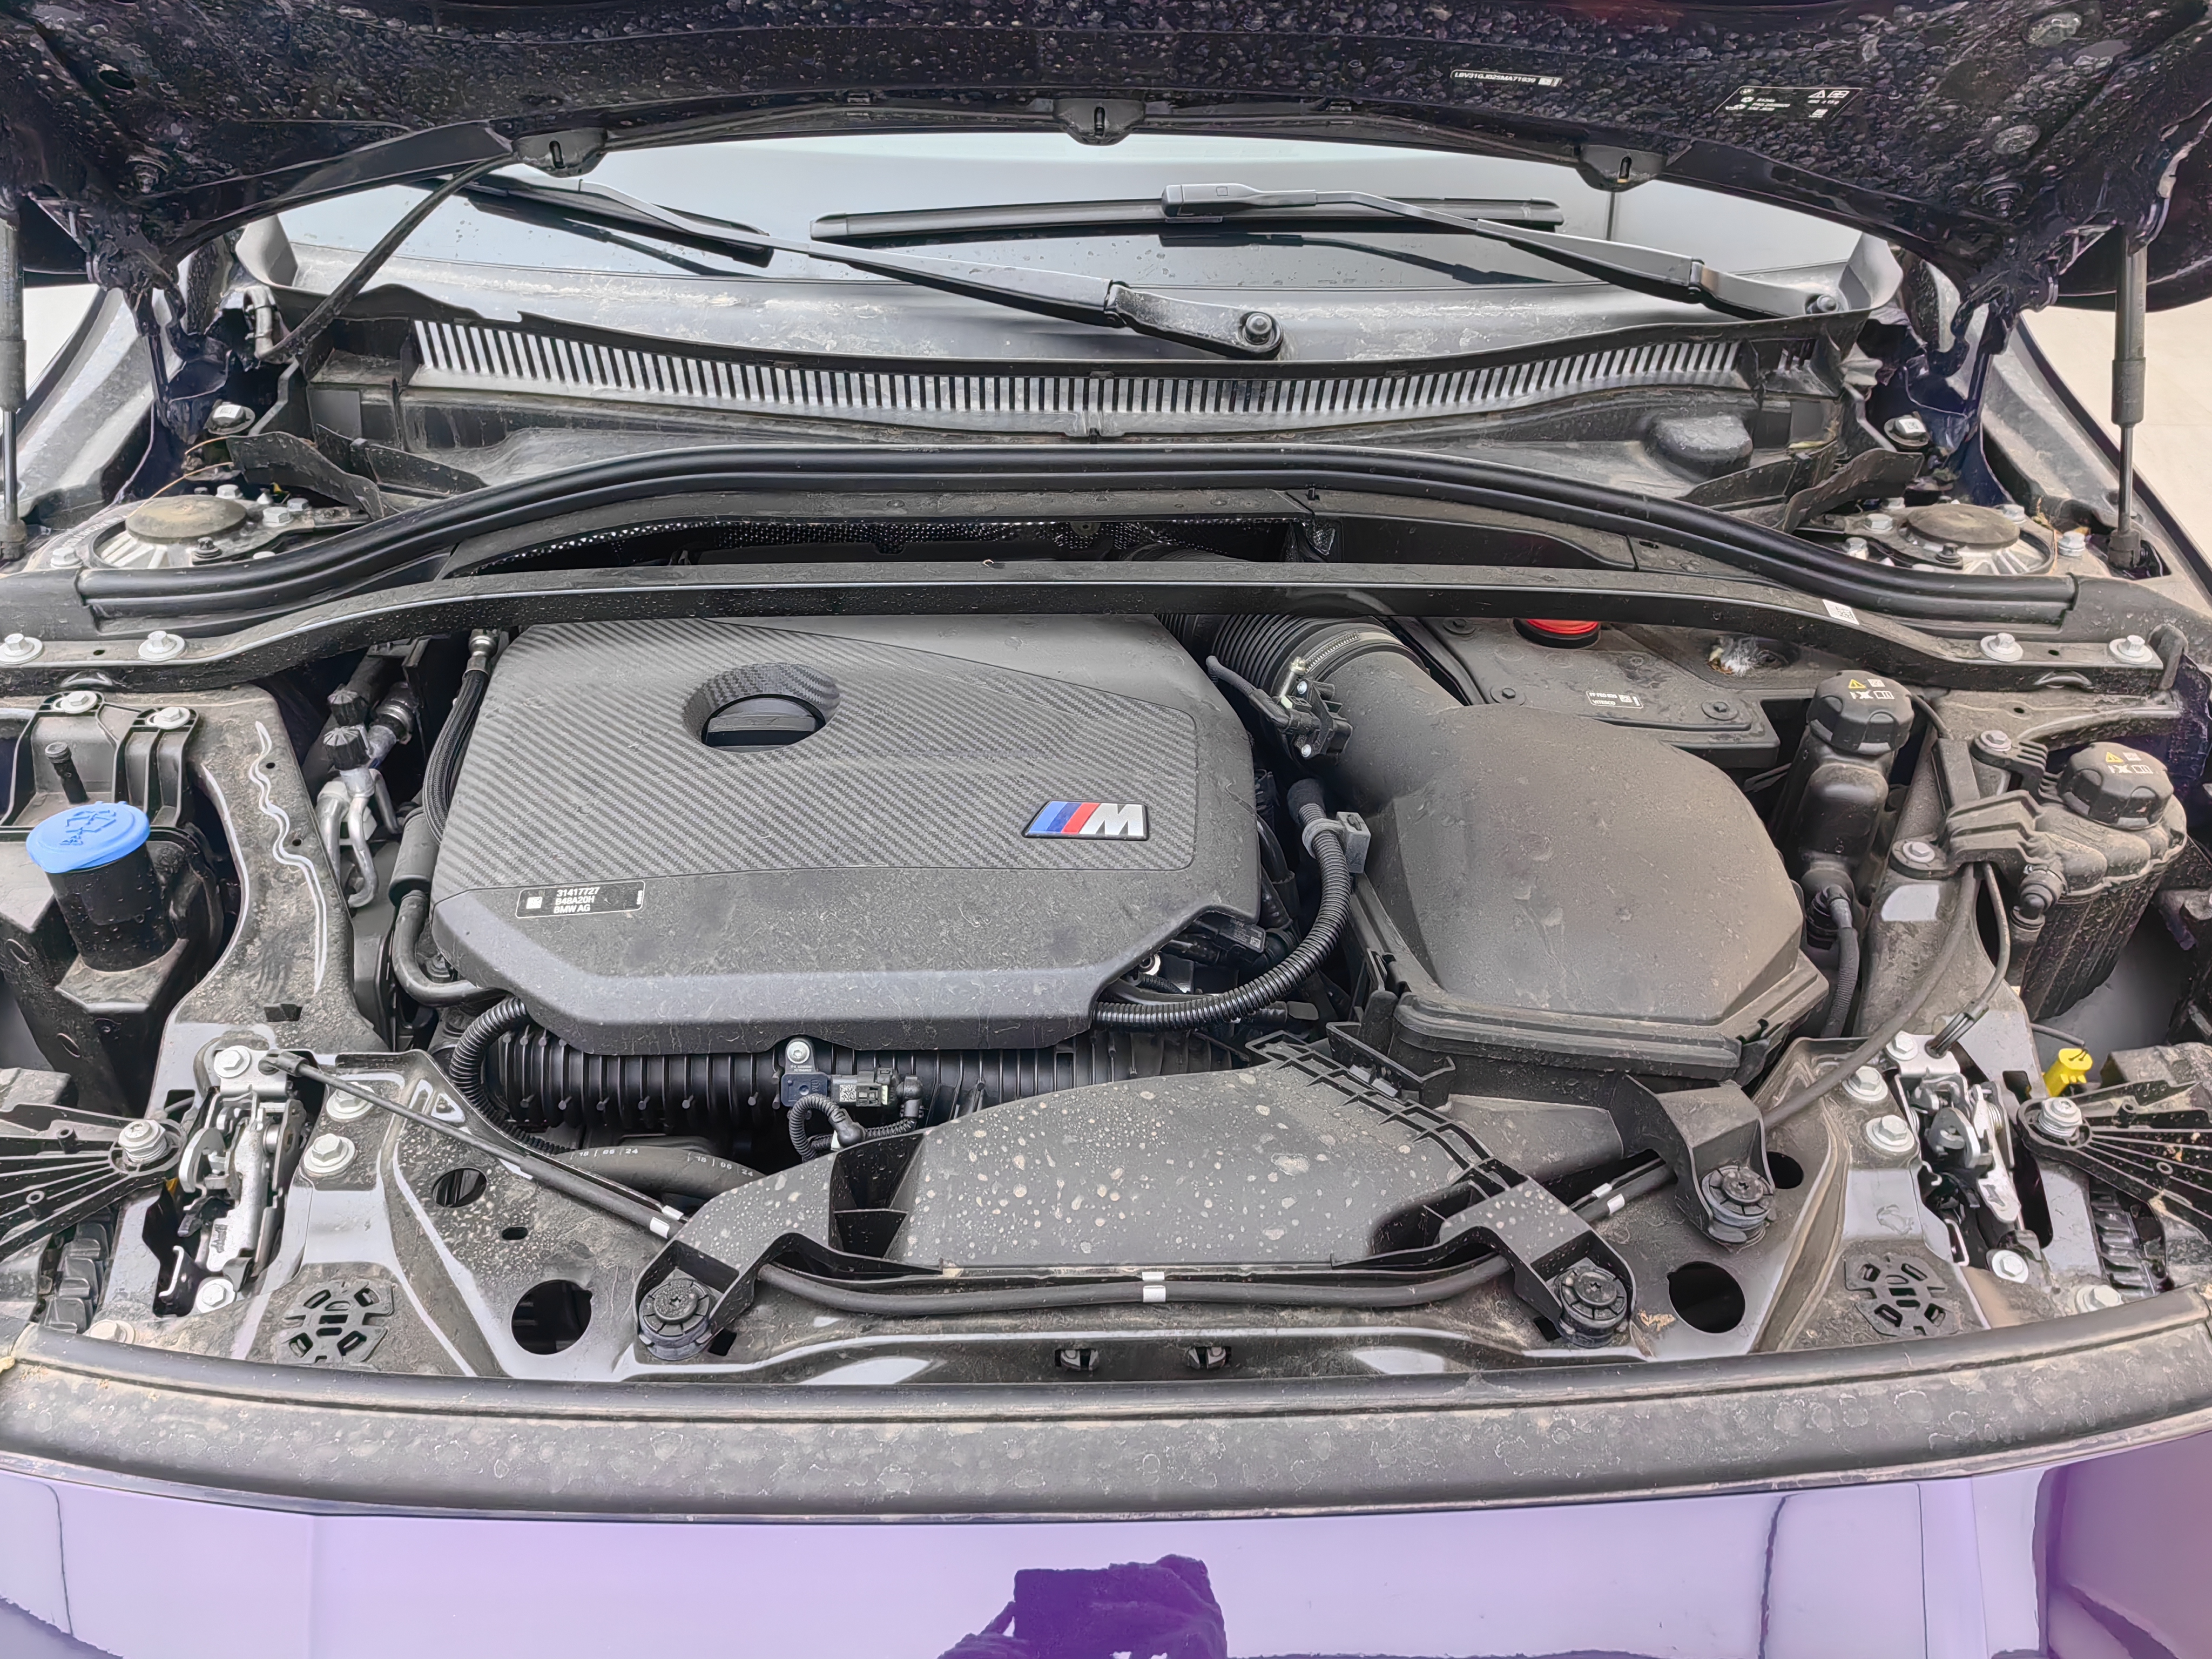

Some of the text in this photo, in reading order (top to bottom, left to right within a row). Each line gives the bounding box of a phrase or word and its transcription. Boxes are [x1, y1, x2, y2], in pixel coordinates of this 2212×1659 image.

[1079, 803, 1144, 837] M
[556, 886, 600, 897] 31417727
[555, 895, 595, 906] B48A20H
[554, 903, 591, 914] BMW AG
